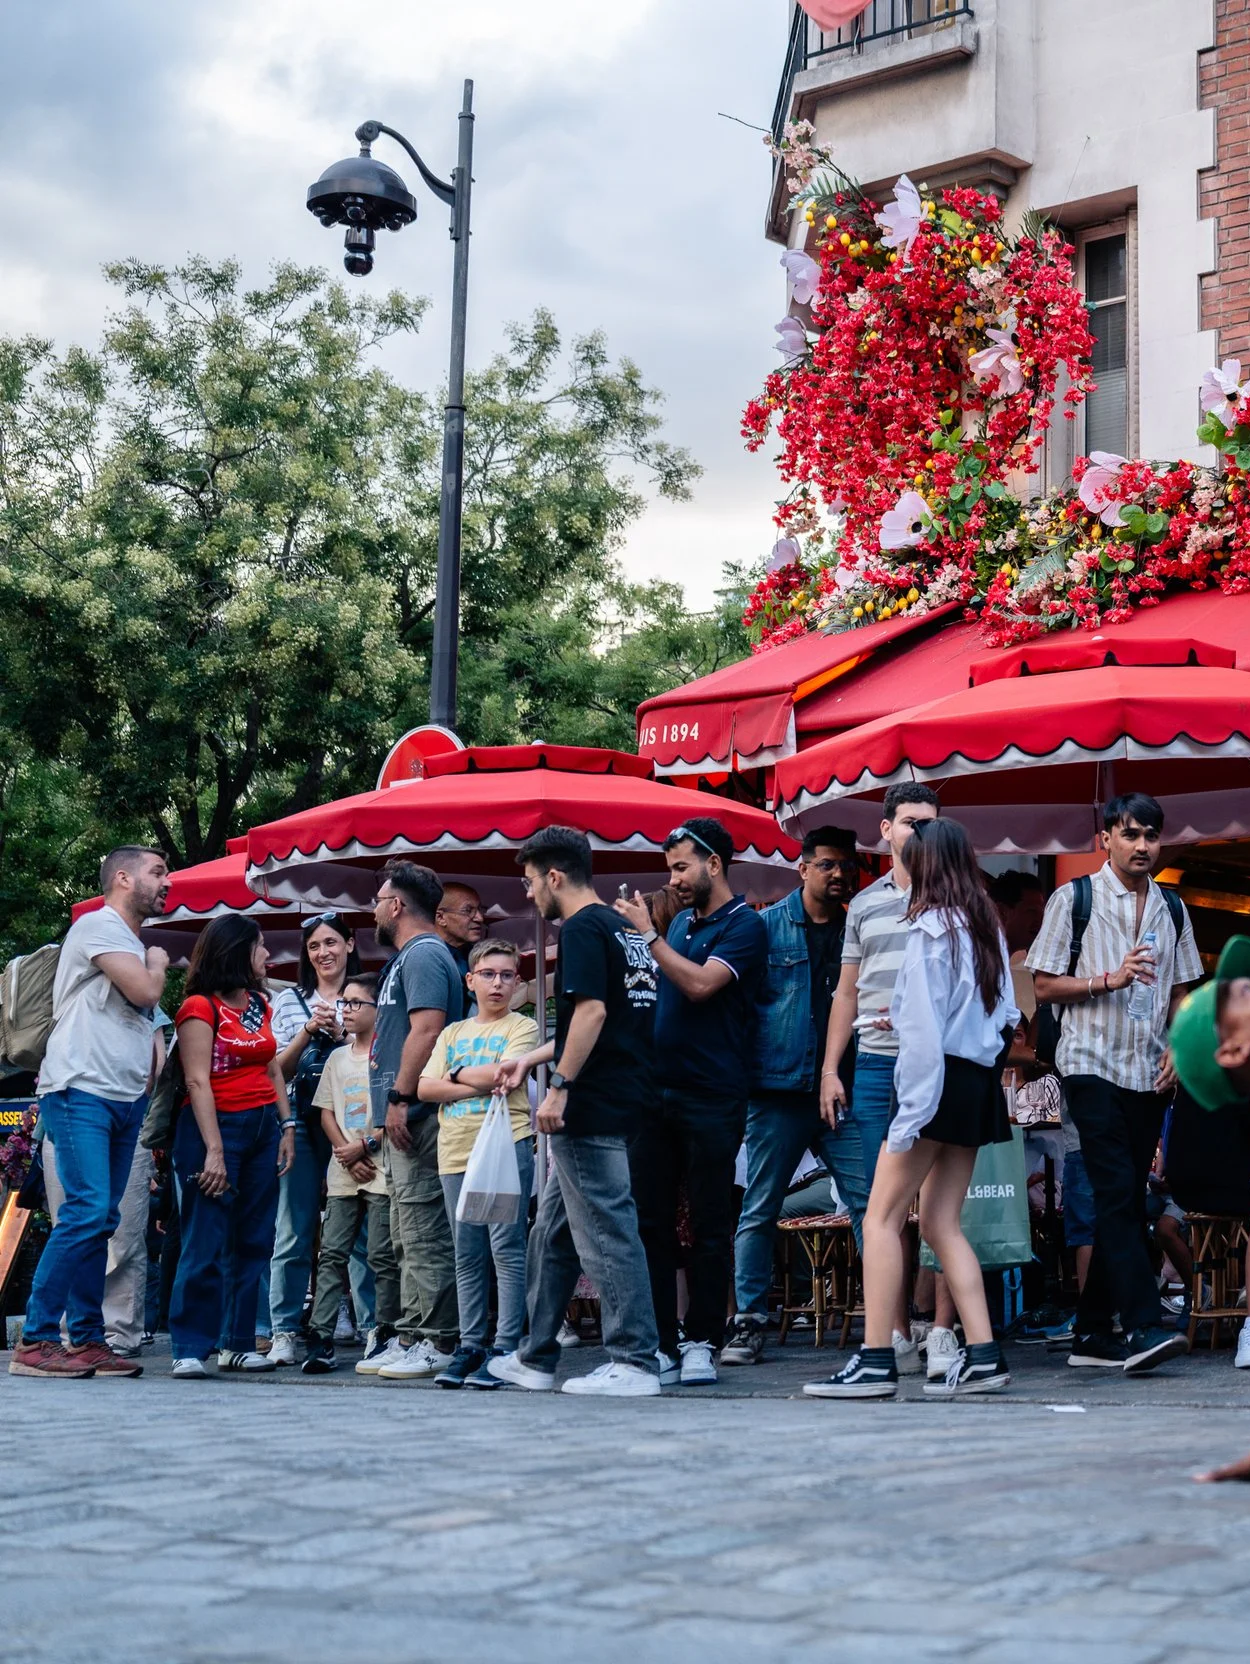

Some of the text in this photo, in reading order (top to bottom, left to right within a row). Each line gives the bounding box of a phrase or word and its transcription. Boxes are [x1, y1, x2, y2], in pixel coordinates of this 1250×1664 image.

[662, 722, 699, 743] 1894
[614, 931, 653, 970] VAN
[965, 1184, 1015, 1199] L&BEAR
